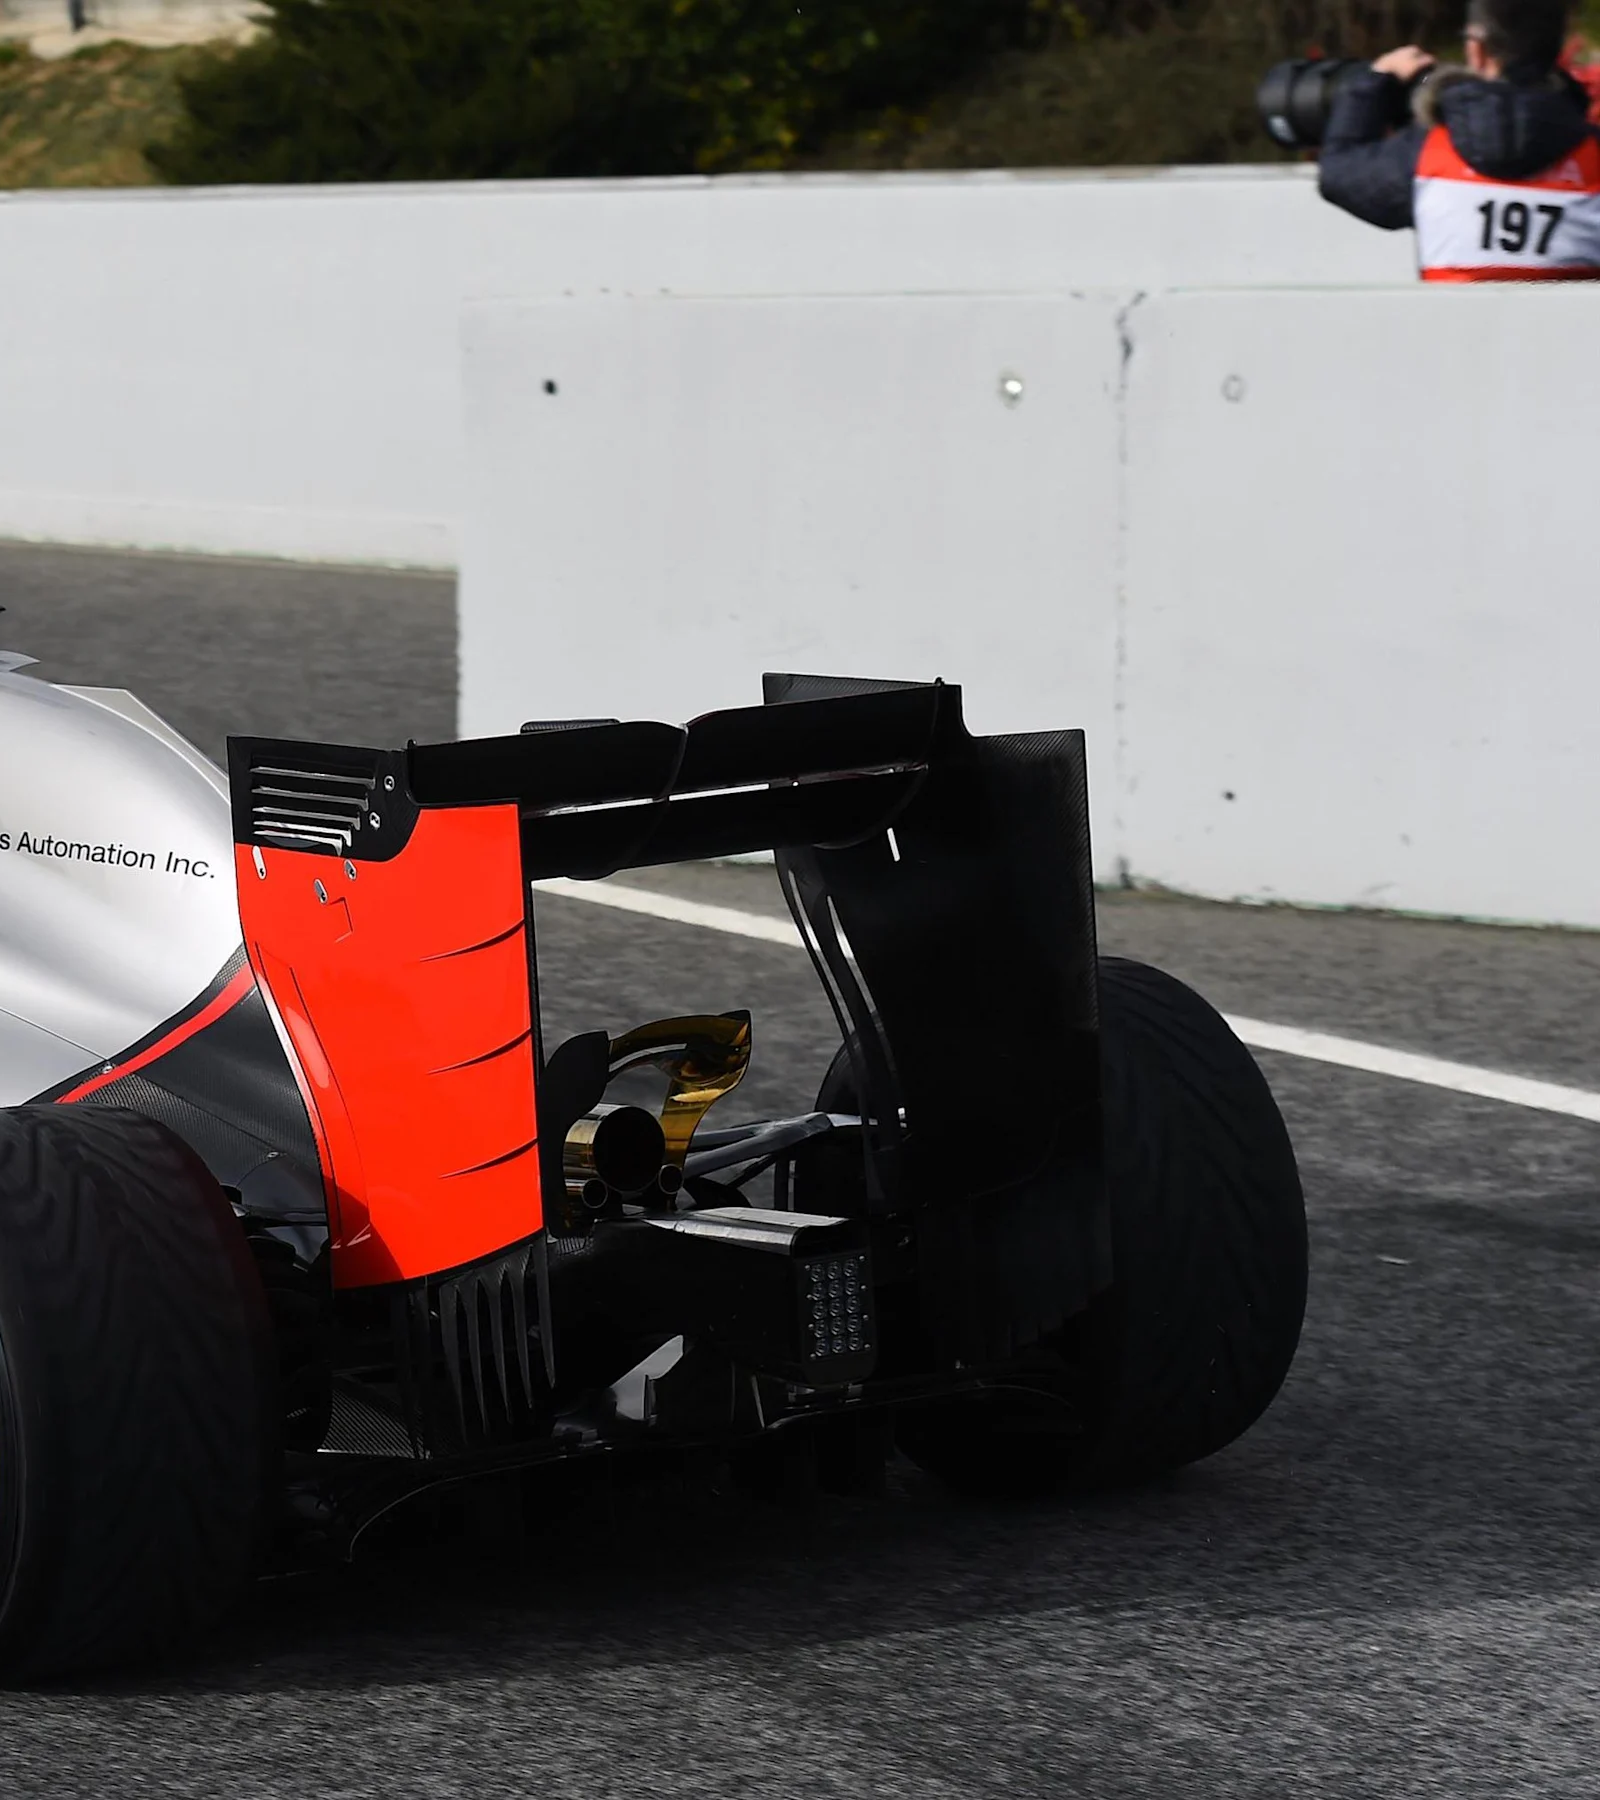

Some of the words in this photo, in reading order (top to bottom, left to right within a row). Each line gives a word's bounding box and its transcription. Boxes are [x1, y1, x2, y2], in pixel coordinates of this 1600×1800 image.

[1478, 200, 1564, 255] 197
[17, 831, 155, 870] Automation
[165, 851, 216, 879] Inc.
